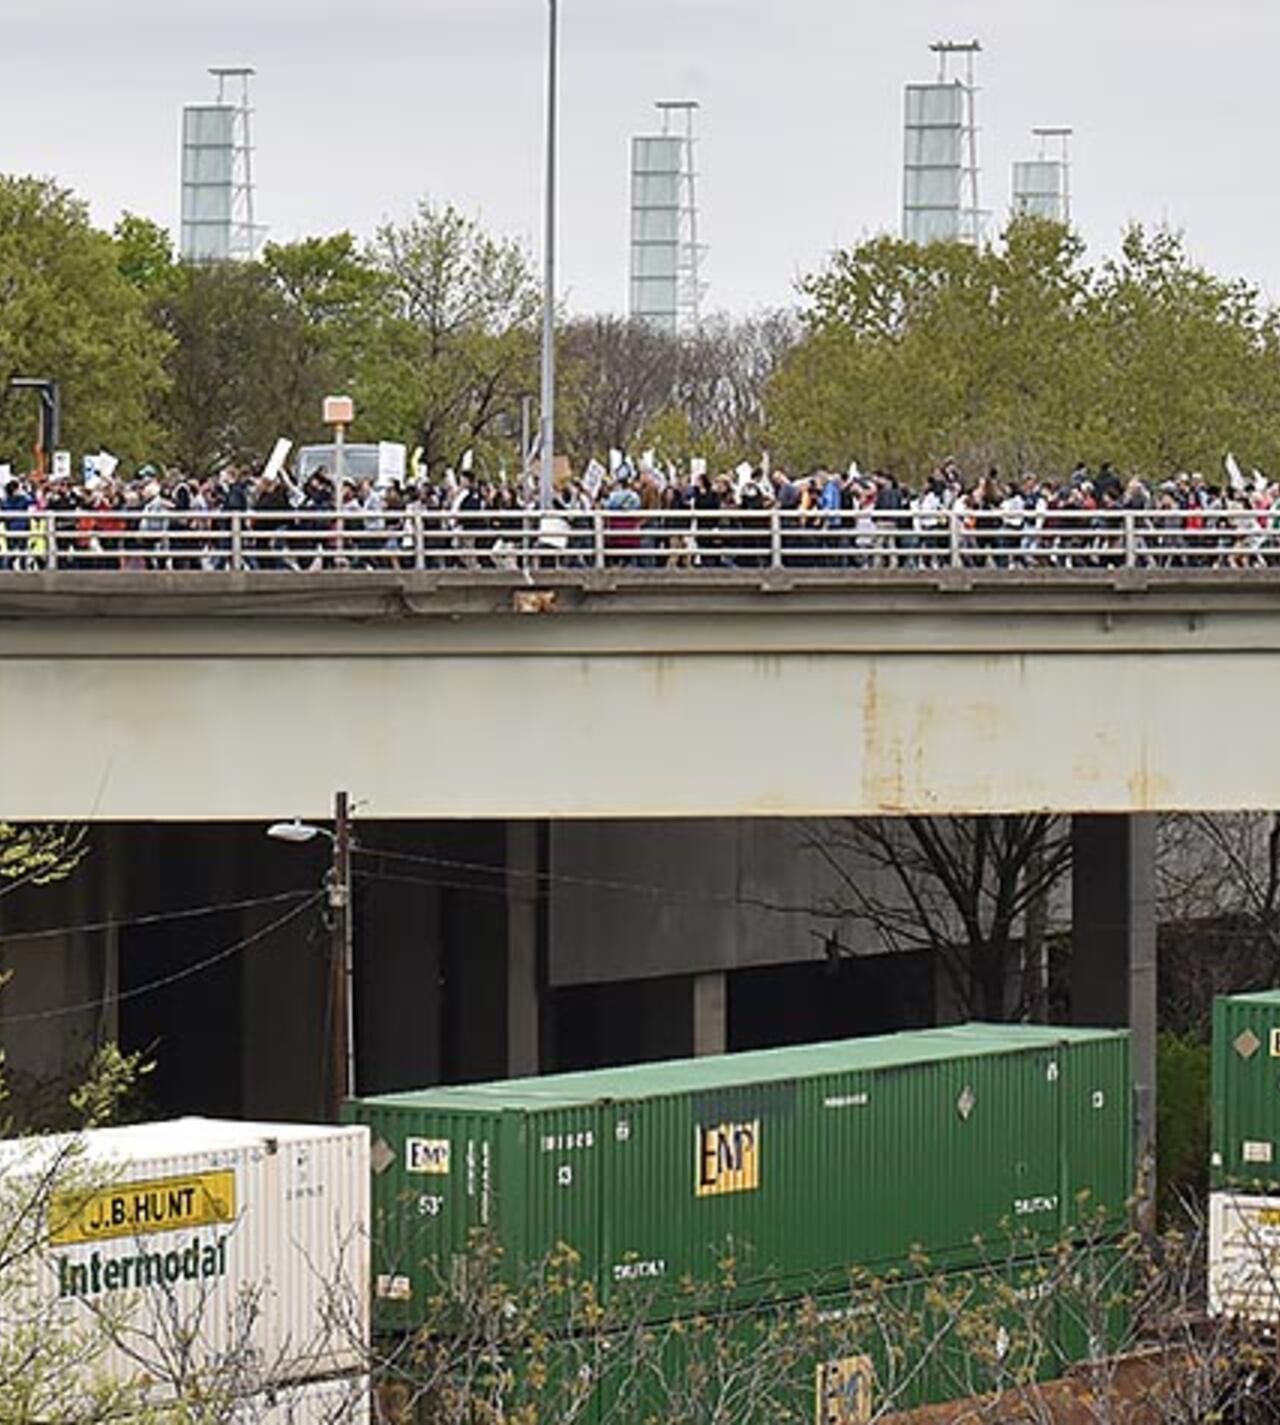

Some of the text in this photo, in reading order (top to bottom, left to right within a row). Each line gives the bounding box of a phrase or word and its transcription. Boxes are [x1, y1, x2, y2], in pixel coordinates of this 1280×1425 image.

[411, 1142, 448, 1168] EMP
[699, 1126, 755, 1187] EMP
[58, 1235, 227, 1298] Intermodal
